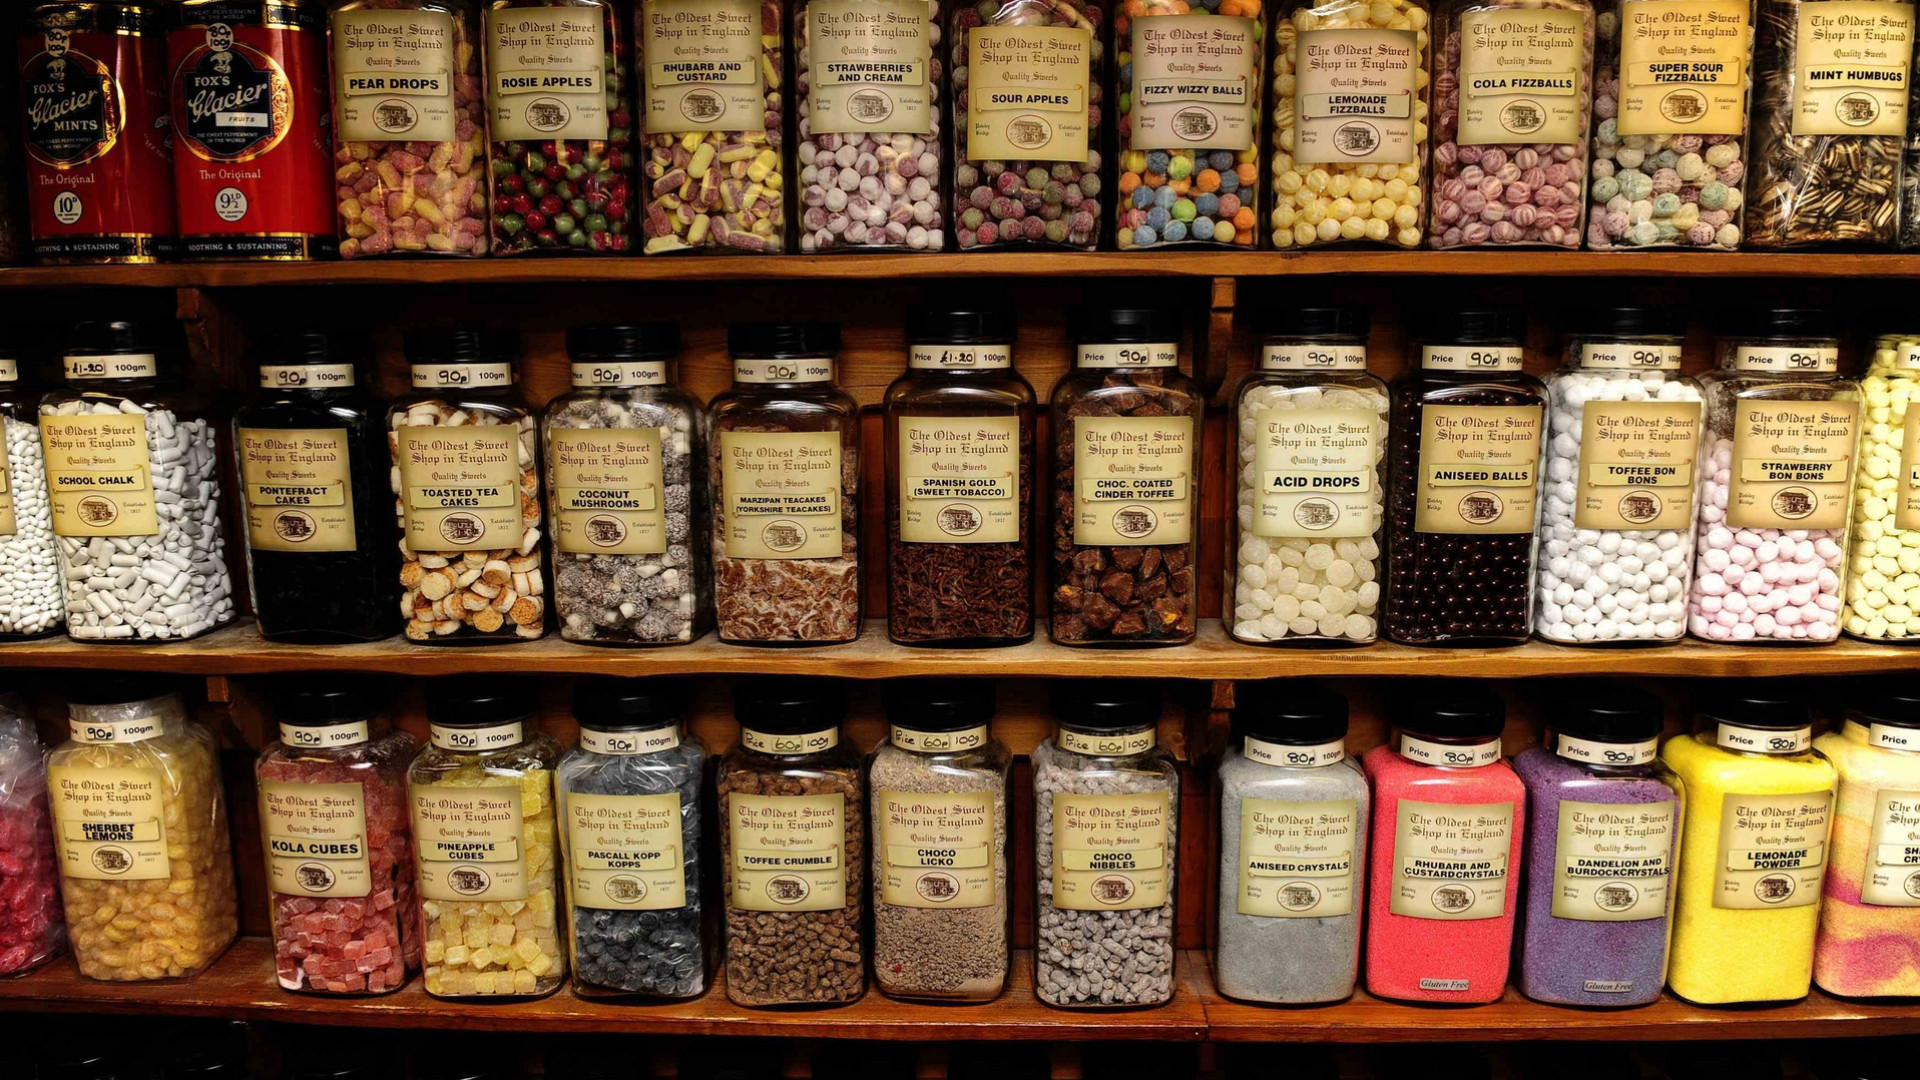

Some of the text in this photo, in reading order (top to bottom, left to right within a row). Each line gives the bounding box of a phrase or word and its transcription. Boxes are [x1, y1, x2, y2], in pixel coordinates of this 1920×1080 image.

[651, 12, 752, 26] The Oldest Sweet
[653, 25, 750, 40] Shop in England
[664, 63, 714, 72] RHUBARB
[828, 64, 912, 72] STRAWBERRIES
[1650, 64, 1723, 72] SUPER SOUR
[194, 76, 230, 86] FOX'S
[677, 73, 726, 81] CUSTARD
[864, 74, 902, 82] CREAM
[1656, 74, 1716, 82] FIZZBALLS
[1811, 71, 1902, 81] MINT HUMBUGS
[350, 79, 438, 89] PEAR DROPS
[502, 78, 592, 88] ROSIE APPLES
[1474, 79, 1572, 88] COLA FIZZBALLS
[34, 83, 65, 94] FOX'S
[1145, 86, 1173, 94] FIZZY
[1213, 86, 1242, 95] BALLS
[188, 83, 268, 122] Glacier
[992, 94, 1068, 104] SOUR APPLES
[1329, 96, 1386, 104] LEMONADE
[28, 90, 98, 130] Glacier
[1330, 106, 1385, 114] FIZZBALLS
[54, 120, 98, 131] MINTS
[40, 173, 95, 188] The Original
[200, 169, 261, 182] The Original
[914, 353, 931, 362] Price
[984, 354, 1006, 362] 100gm
[1120, 350, 1146, 364] 90p
[1271, 352, 1334, 366] Price 90p
[1469, 352, 1499, 366] 90p
[1592, 351, 1660, 366] Price 90p
[1789, 354, 1818, 369] 90p
[116, 364, 146, 372] 100gm
[766, 365, 829, 380] 90p 100gm
[277, 371, 307, 386] 90p
[439, 370, 505, 384] 90p 100gm
[592, 368, 659, 382] 90p 100gm
[909, 429, 1010, 442] The Oldest Sweet
[910, 442, 1008, 456] Shop in England
[932, 462, 987, 472] Quality Sweets
[1608, 467, 1650, 475] TOFFEE
[99, 476, 134, 484] CHALK
[1435, 472, 1527, 480] ANISEED BALLS
[1628, 476, 1657, 484] BONS
[1133, 480, 1172, 488] COATED
[1274, 477, 1359, 487] ACID DROPS
[260, 487, 327, 495] PONTEFRACT
[422, 488, 498, 497] TOASTED TEA
[579, 490, 629, 498] COCONUT
[914, 488, 950, 496] (SWEET
[1137, 490, 1174, 498] TOFFEE
[275, 496, 311, 504] CAKES
[441, 498, 478, 506] CAKES
[572, 500, 639, 508] MUSHROOMS
[87, 726, 153, 741] 90p 100gm
[294, 731, 320, 746] 90p
[450, 733, 514, 747] 90p 100gm
[1769, 738, 1795, 751] 80p
[608, 739, 632, 752] 90p
[1252, 748, 1315, 765] Price 80p
[1409, 747, 1474, 763] Price 80p
[1604, 751, 1634, 764] 80p
[82, 824, 134, 832] SHERBET
[85, 832, 133, 841] LEMONS
[272, 841, 358, 854] KOLA CUBES
[1748, 850, 1807, 860] LEMONADE
[744, 856, 831, 865] TOFFEE CRUMBLE
[1090, 861, 1135, 869] NIBBLES
[1416, 860, 1466, 870] RHUBARB
[1643, 858, 1661, 866] AND
[1754, 859, 1800, 870] POWDER
[1250, 862, 1348, 871] ANISEED CRYSTALS
